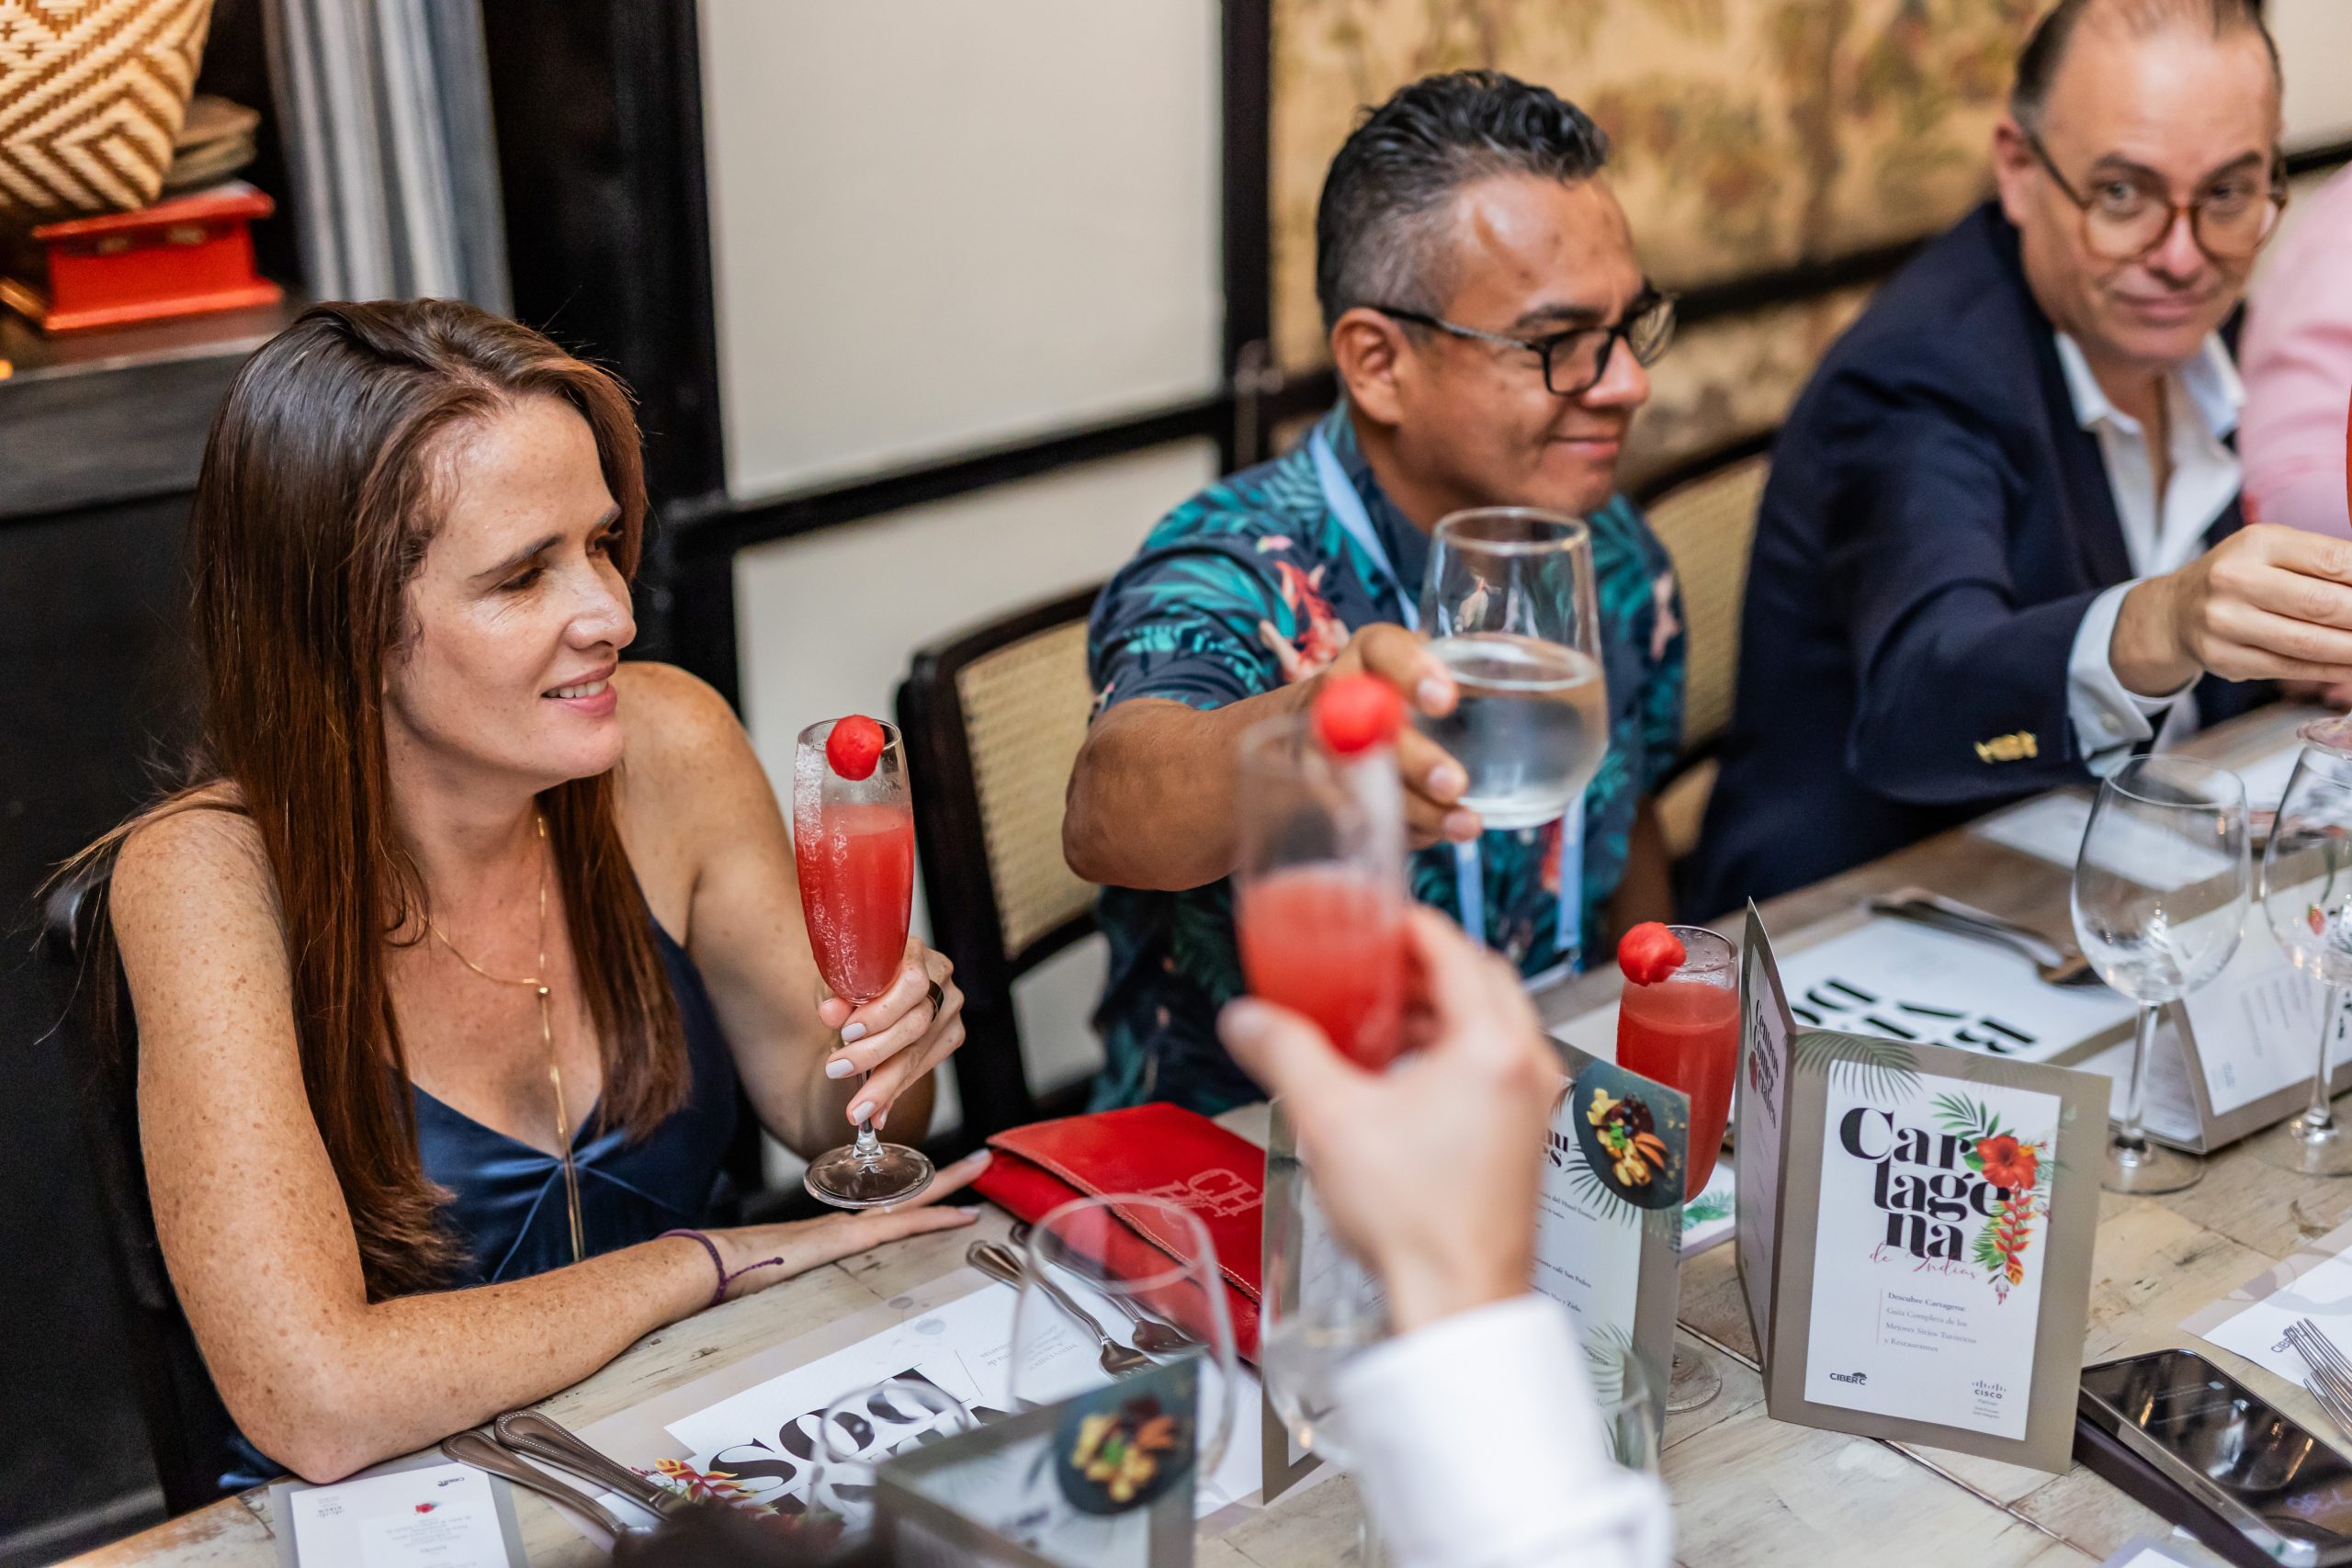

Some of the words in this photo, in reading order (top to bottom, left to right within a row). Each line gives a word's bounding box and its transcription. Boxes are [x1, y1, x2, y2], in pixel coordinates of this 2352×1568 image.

[1840, 1107, 1972, 1172] Car
[1874, 1156, 2012, 1222] tage
[1884, 1211, 1967, 1263] na
[1887, 1292, 1924, 1304] Descubre
[1945, 1316, 1955, 1325] de
[1885, 1322, 1916, 1333] Mejores
[1891, 1337, 1939, 1352] Restaurantes
[1974, 1389, 2003, 1400] CISCO
